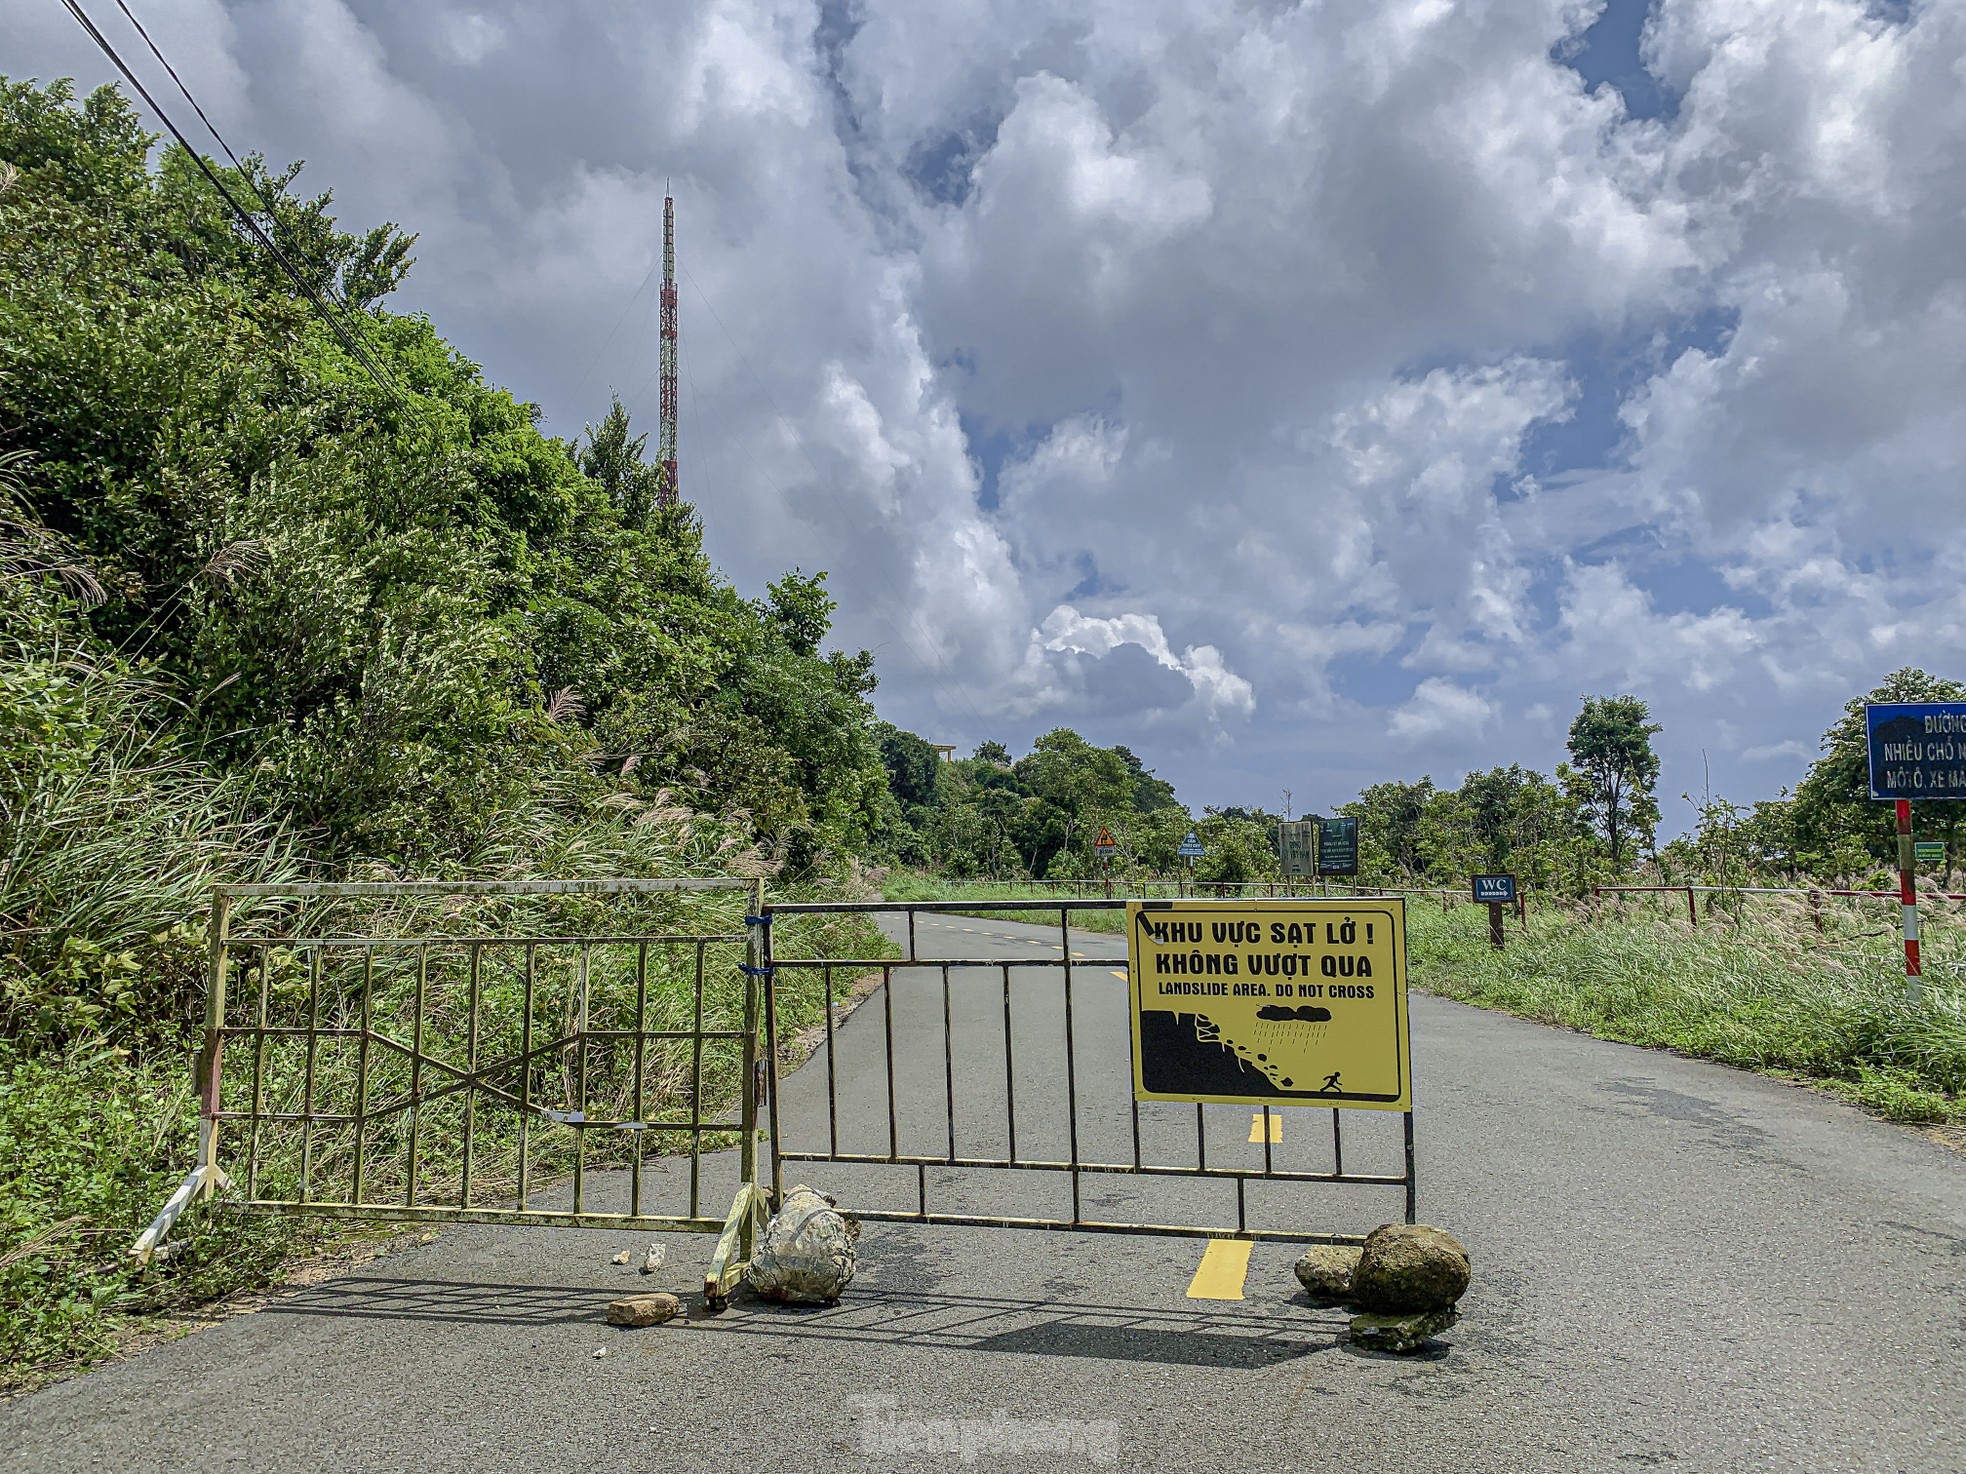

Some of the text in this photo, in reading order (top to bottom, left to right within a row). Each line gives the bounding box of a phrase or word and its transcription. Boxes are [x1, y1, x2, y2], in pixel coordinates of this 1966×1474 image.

[1884, 735, 1923, 762] NHIỀU
[1481, 879, 1507, 891] WC
[1154, 921, 1203, 943] KHU
[1212, 920, 1261, 949] VỰC
[1270, 921, 1317, 949] SẠT
[1326, 916, 1357, 945] LỞ
[1156, 949, 1373, 981] KHÔNG VƯỢT QUA
[1158, 981, 1375, 999] LANDSLIDE AREA. DO NOT CROSS
